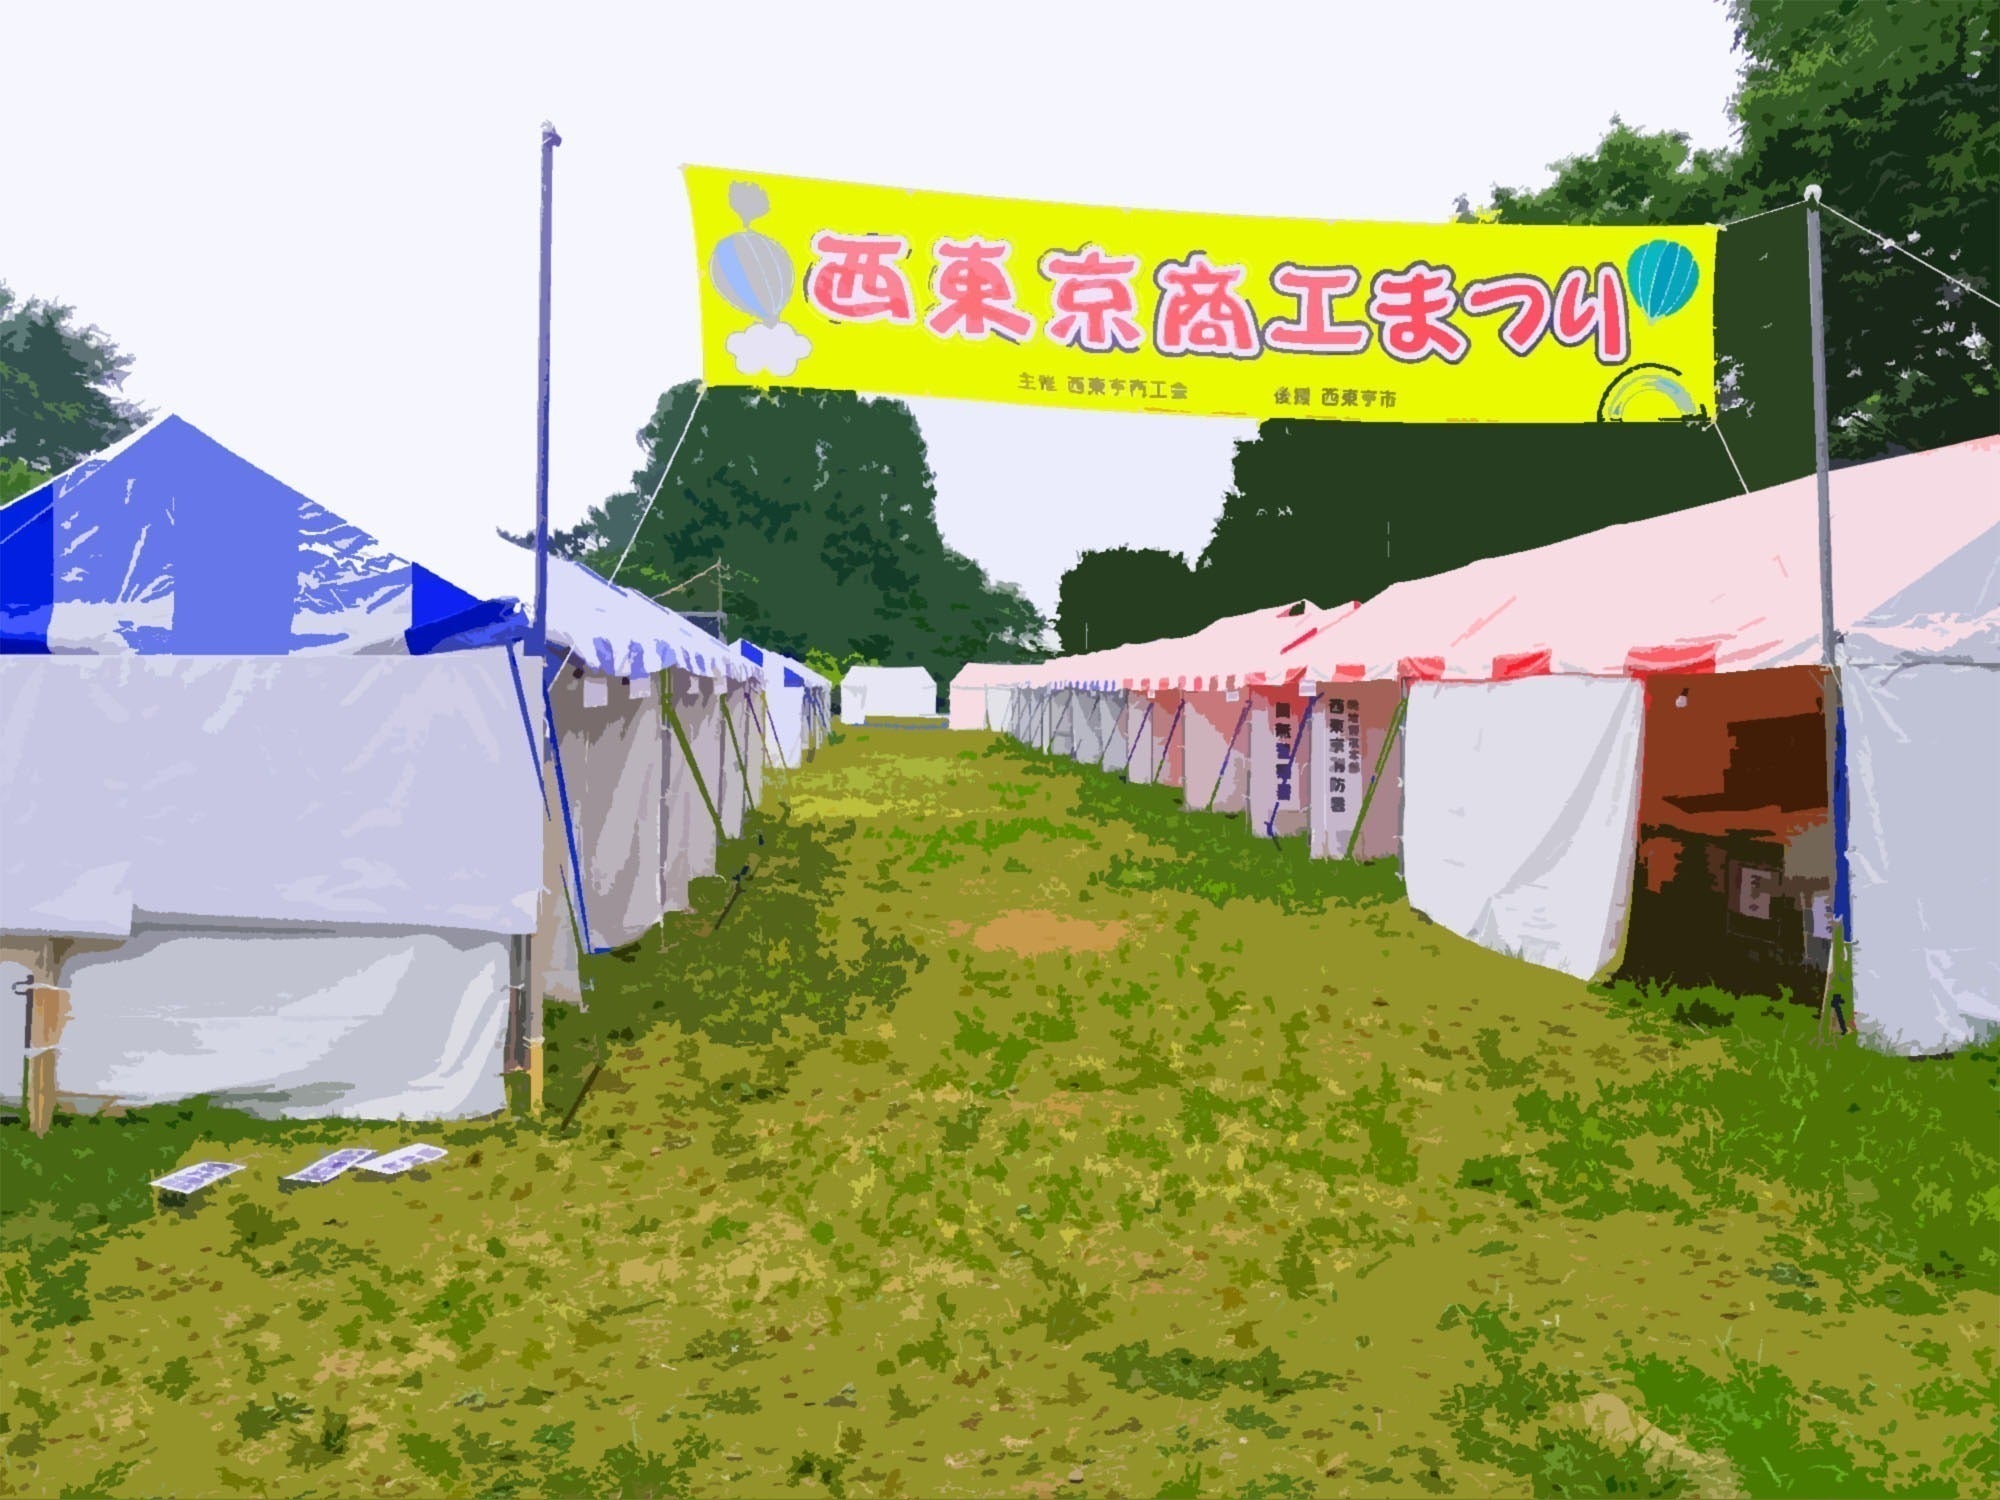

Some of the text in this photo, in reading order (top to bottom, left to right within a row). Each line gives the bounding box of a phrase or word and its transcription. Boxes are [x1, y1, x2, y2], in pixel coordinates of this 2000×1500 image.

[809, 231, 1629, 362] 西東京商工まつり
